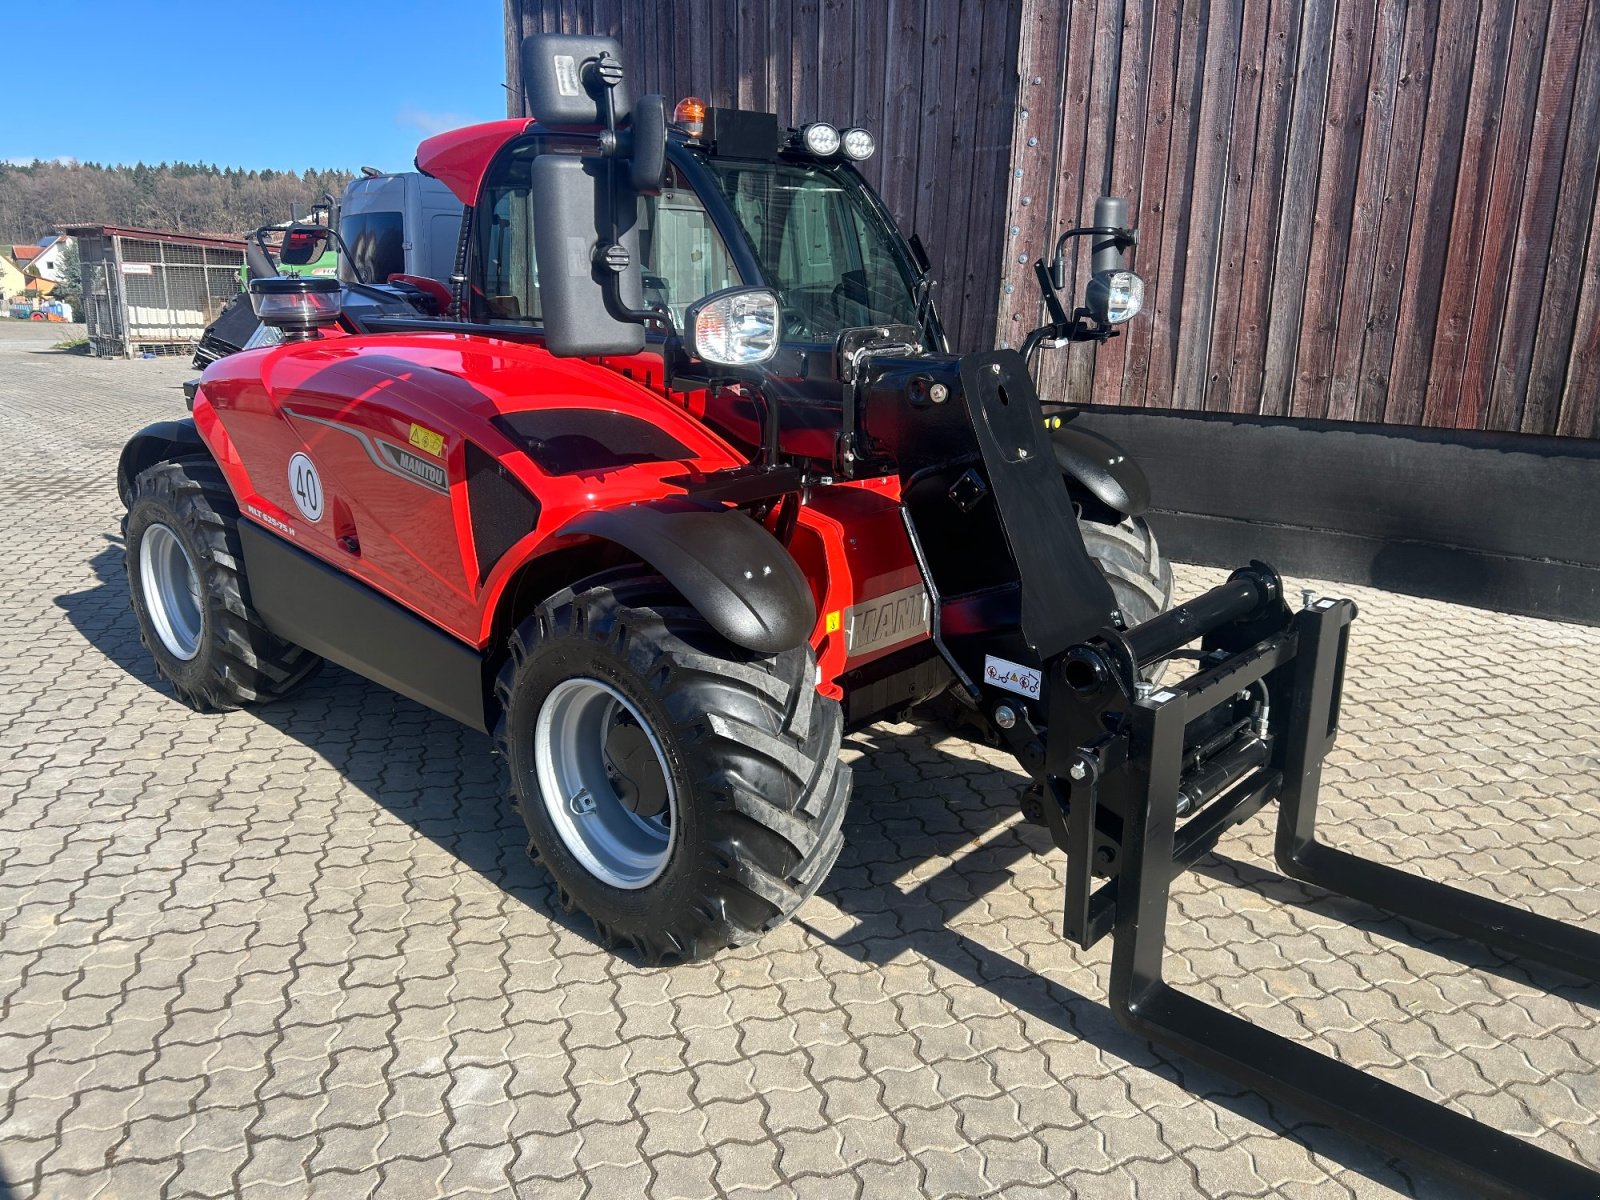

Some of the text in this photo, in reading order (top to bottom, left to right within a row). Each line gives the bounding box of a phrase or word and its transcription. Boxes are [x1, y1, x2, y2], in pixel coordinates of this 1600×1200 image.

[400, 452, 443, 485] MANITOU
[296, 465, 317, 511] 40
[247, 504, 262, 518] MLT
